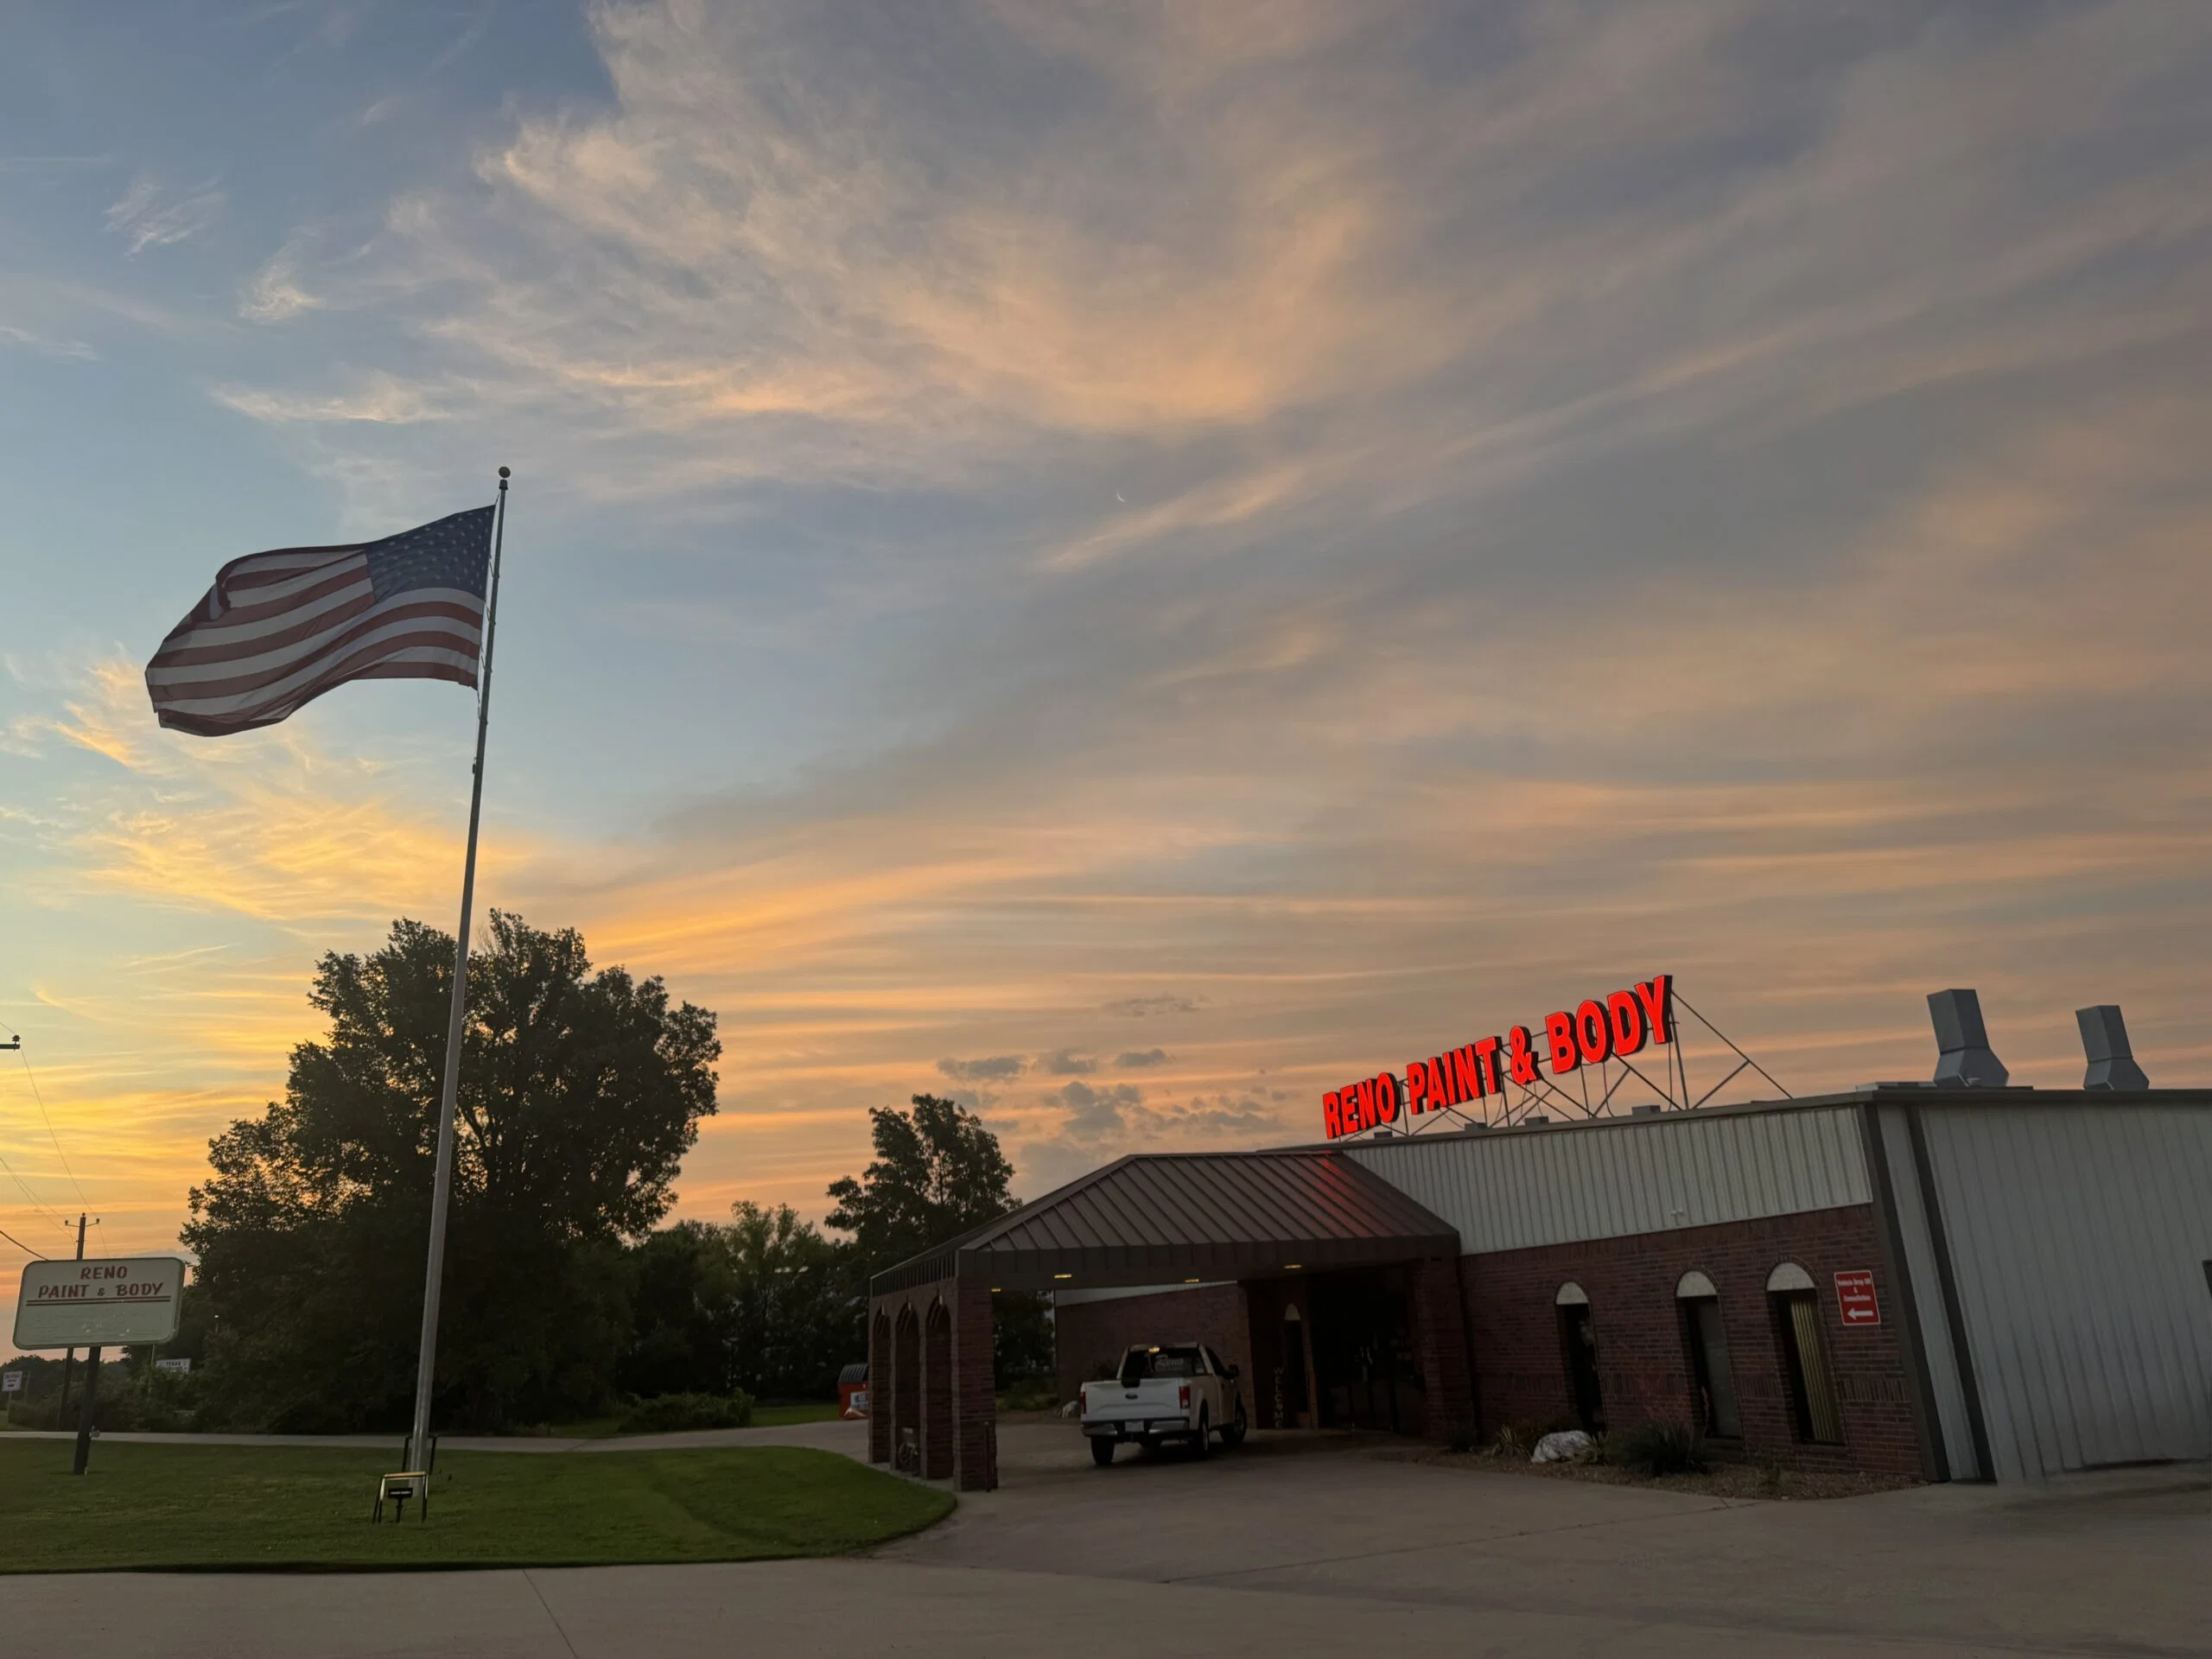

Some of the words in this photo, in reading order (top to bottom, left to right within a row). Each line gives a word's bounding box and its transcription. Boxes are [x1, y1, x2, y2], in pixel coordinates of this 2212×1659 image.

[1323, 1072, 1398, 1139] RENO
[1407, 1036, 1501, 1115] PAINT
[1510, 1026, 1539, 1085] &
[1545, 975, 1672, 1074] BODY
[80, 1265, 128, 1280] RENO
[38, 1284, 90, 1299] PAINT
[97, 1287, 105, 1297] &
[116, 1282, 164, 1297] BODY
